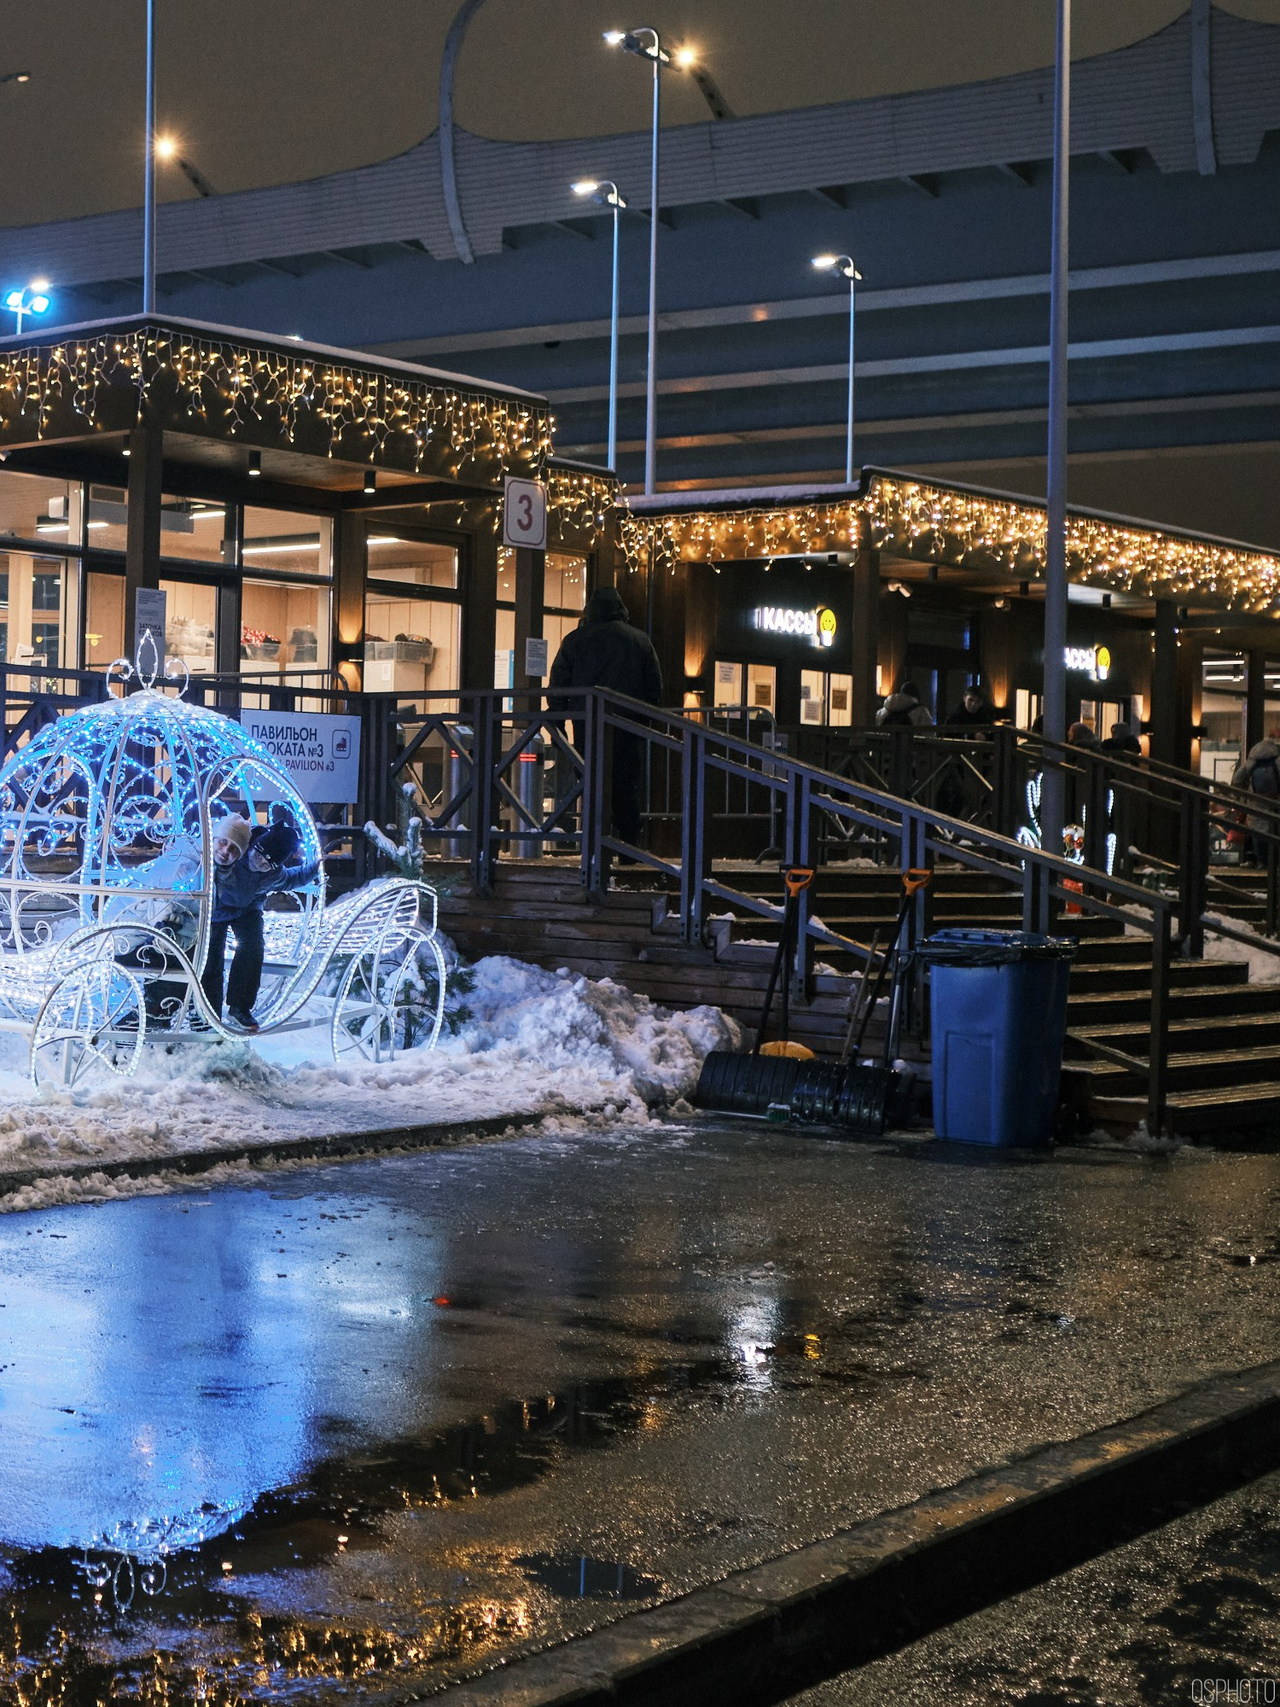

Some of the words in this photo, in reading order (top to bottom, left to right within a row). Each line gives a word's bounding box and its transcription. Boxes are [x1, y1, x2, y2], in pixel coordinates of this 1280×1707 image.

[517, 494, 533, 531] 3
[763, 606, 817, 635] КАССЫ
[251, 724, 318, 742] ПАВИЛЬОН
[308, 743, 324, 758] №3
[285, 759, 324, 772] PAVILION
[325, 761, 335, 772] #3
